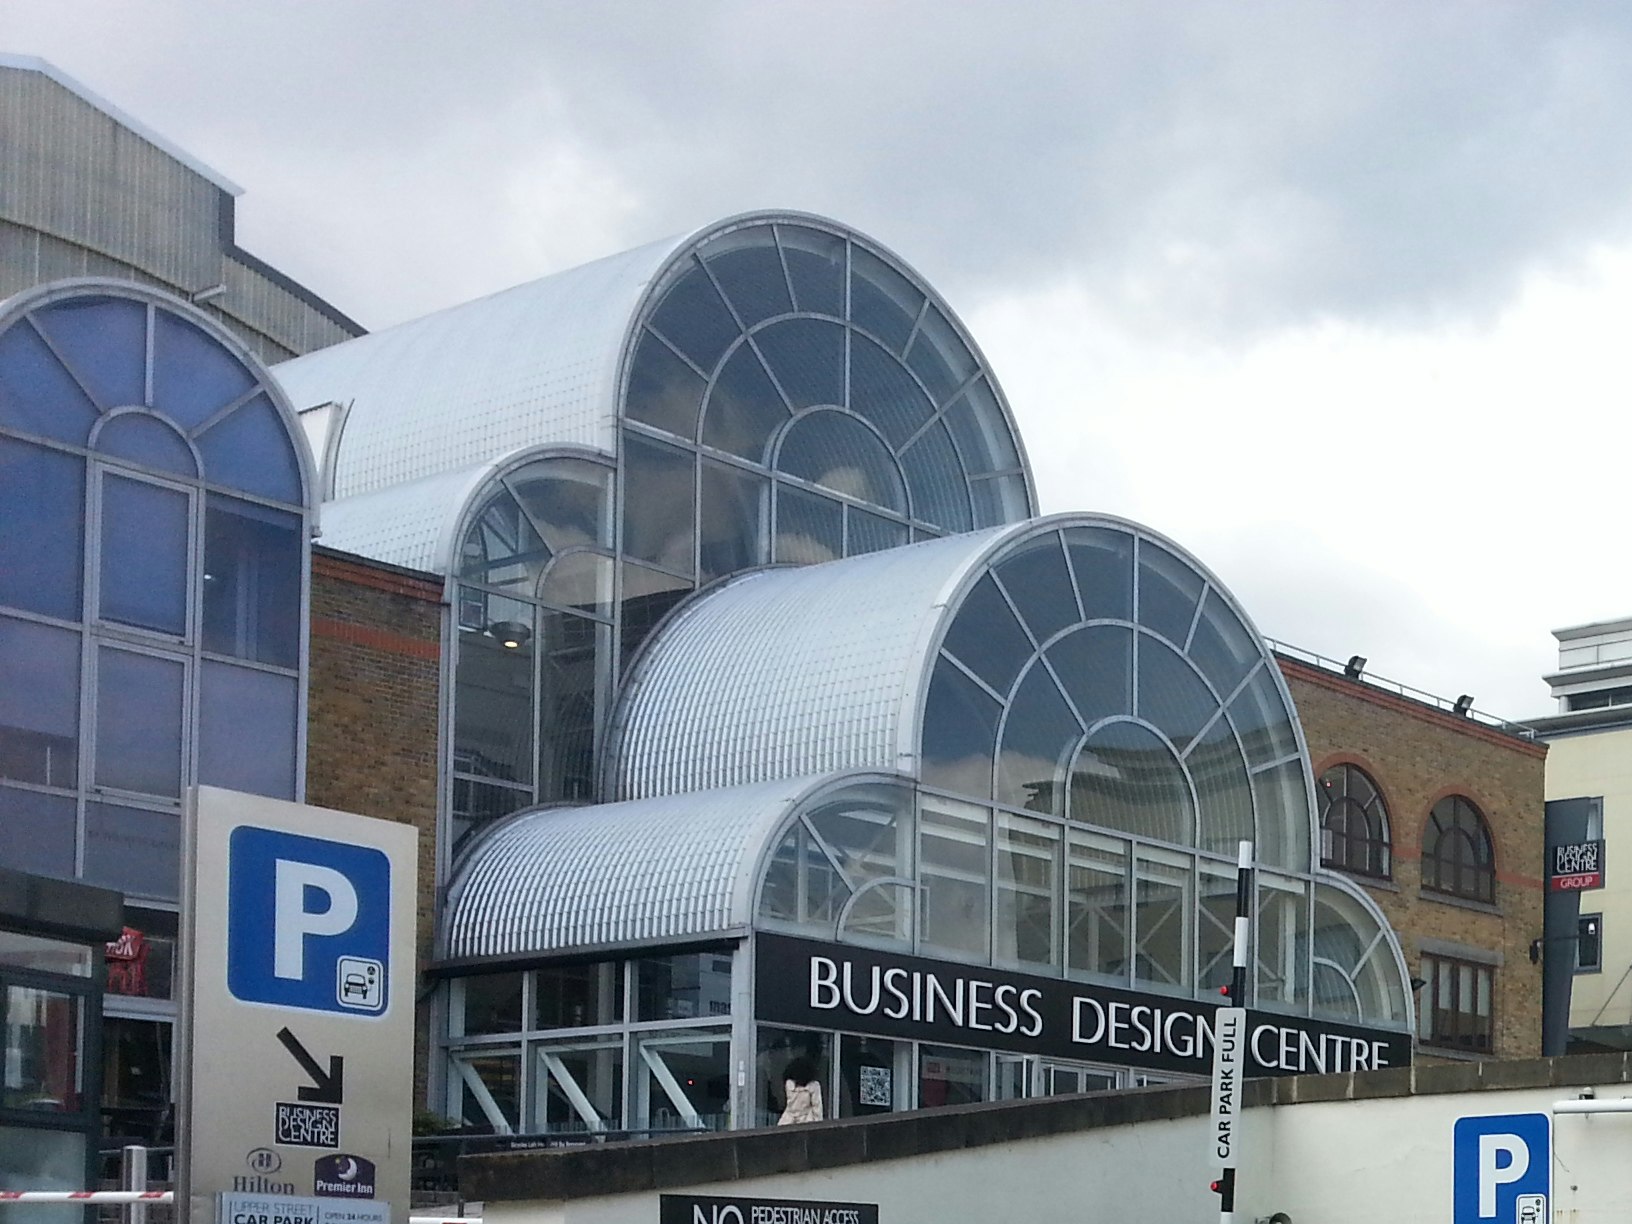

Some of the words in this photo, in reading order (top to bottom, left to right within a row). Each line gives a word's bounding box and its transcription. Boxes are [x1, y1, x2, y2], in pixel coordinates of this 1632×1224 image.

[1557, 859, 1597, 873] CENTRE
[1560, 876, 1592, 888] GROUP
[273, 858, 358, 981] P
[809, 956, 1043, 1037] BUSINESS
[1072, 996, 1216, 1059] DESIGN
[1251, 1024, 1389, 1075] CENTRE
[1222, 1017, 1237, 1062] FULL
[1219, 1068, 1234, 1115] PARK
[280, 1106, 336, 1121] BUSINESS
[280, 1114, 335, 1131] DESIGN
[279, 1126, 335, 1145] CENTRE
[1217, 1121, 1231, 1158] CAR
[1479, 1133, 1530, 1218] P
[233, 1176, 295, 1195] Hilton
[316, 1180, 355, 1193] Premier
[357, 1184, 373, 1194] Inn
[234, 1201, 269, 1213] UPPER
[274, 1203, 313, 1216] STREET
